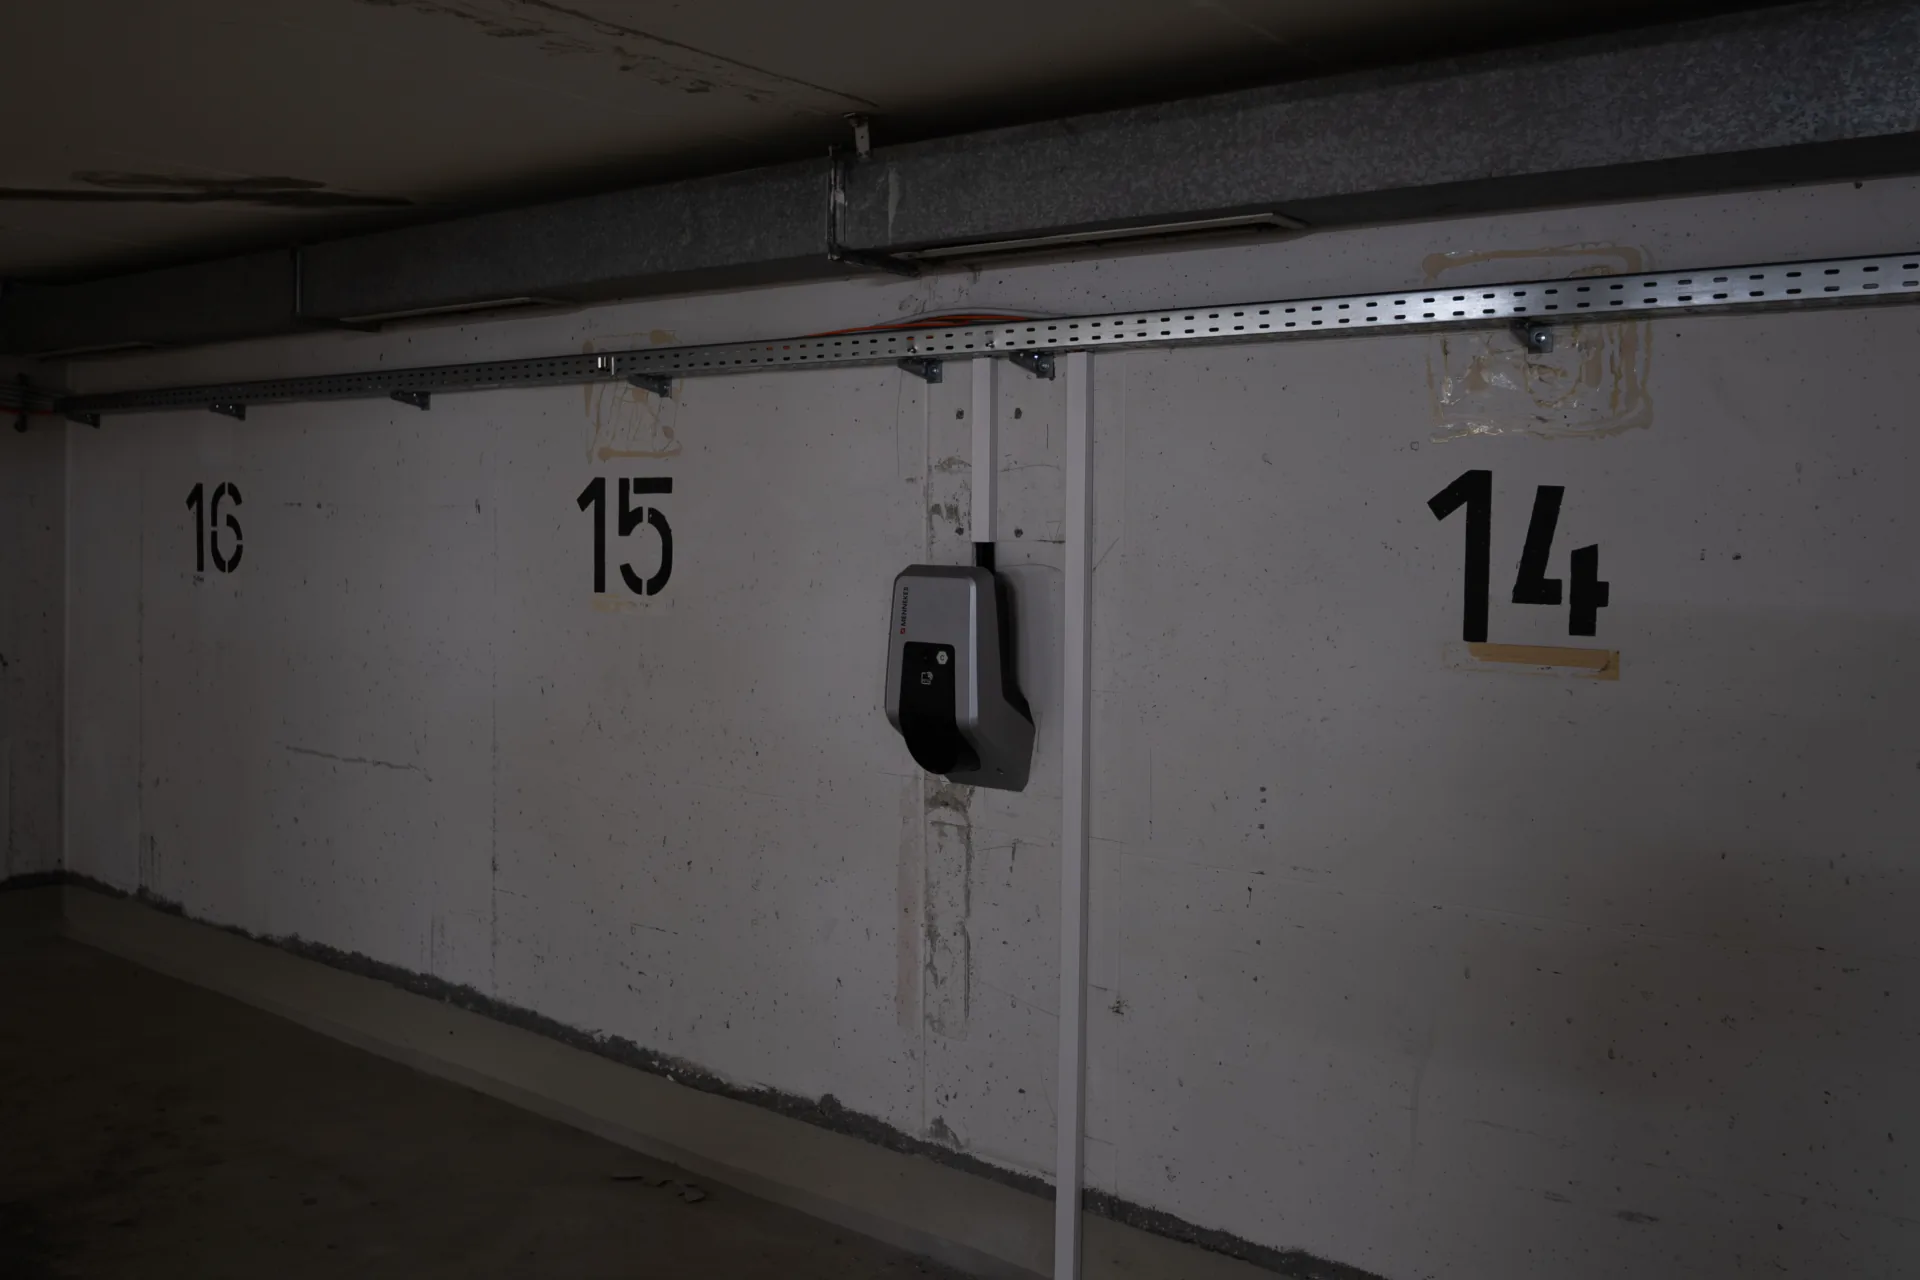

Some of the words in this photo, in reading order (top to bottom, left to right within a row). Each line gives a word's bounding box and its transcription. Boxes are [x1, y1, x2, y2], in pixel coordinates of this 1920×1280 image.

[186, 482, 243, 573] 16
[577, 477, 672, 596] 15
[1427, 470, 1609, 642] 14
[901, 587, 909, 627] MENNEKES
